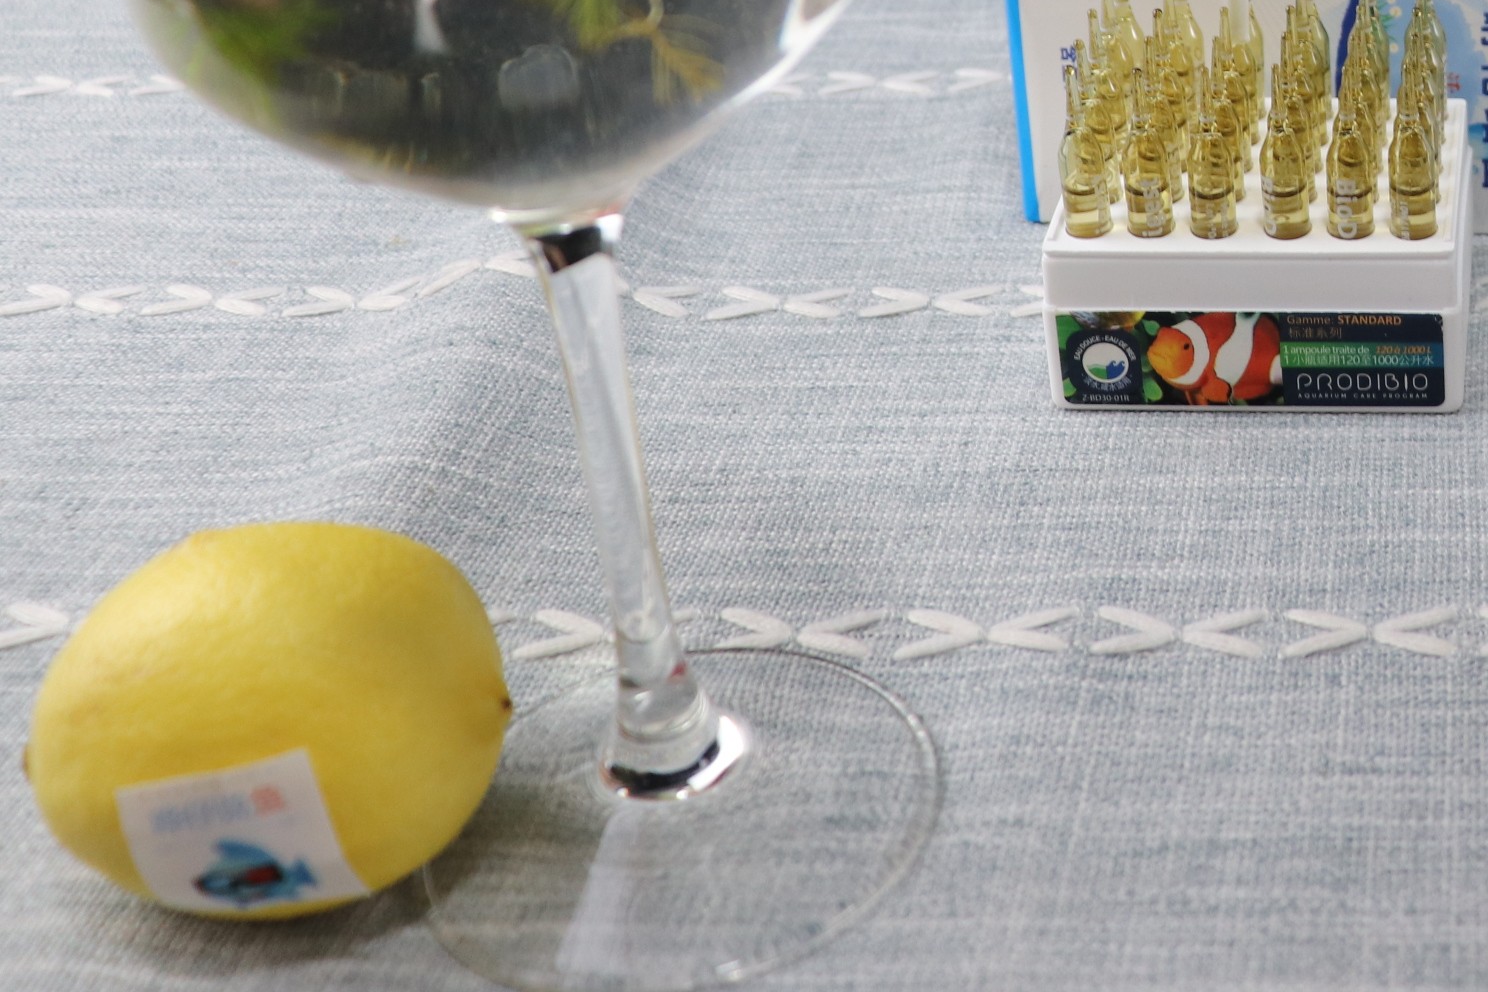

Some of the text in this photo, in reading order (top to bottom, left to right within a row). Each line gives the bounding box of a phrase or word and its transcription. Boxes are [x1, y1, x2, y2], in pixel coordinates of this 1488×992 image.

[1335, 179, 1358, 239] BioD
[1287, 314, 1402, 326] Gamme: STANDARD
[1290, 344, 1331, 356] ampoule
[1357, 344, 1370, 354] de
[1296, 372, 1429, 391] PRODIBIO
